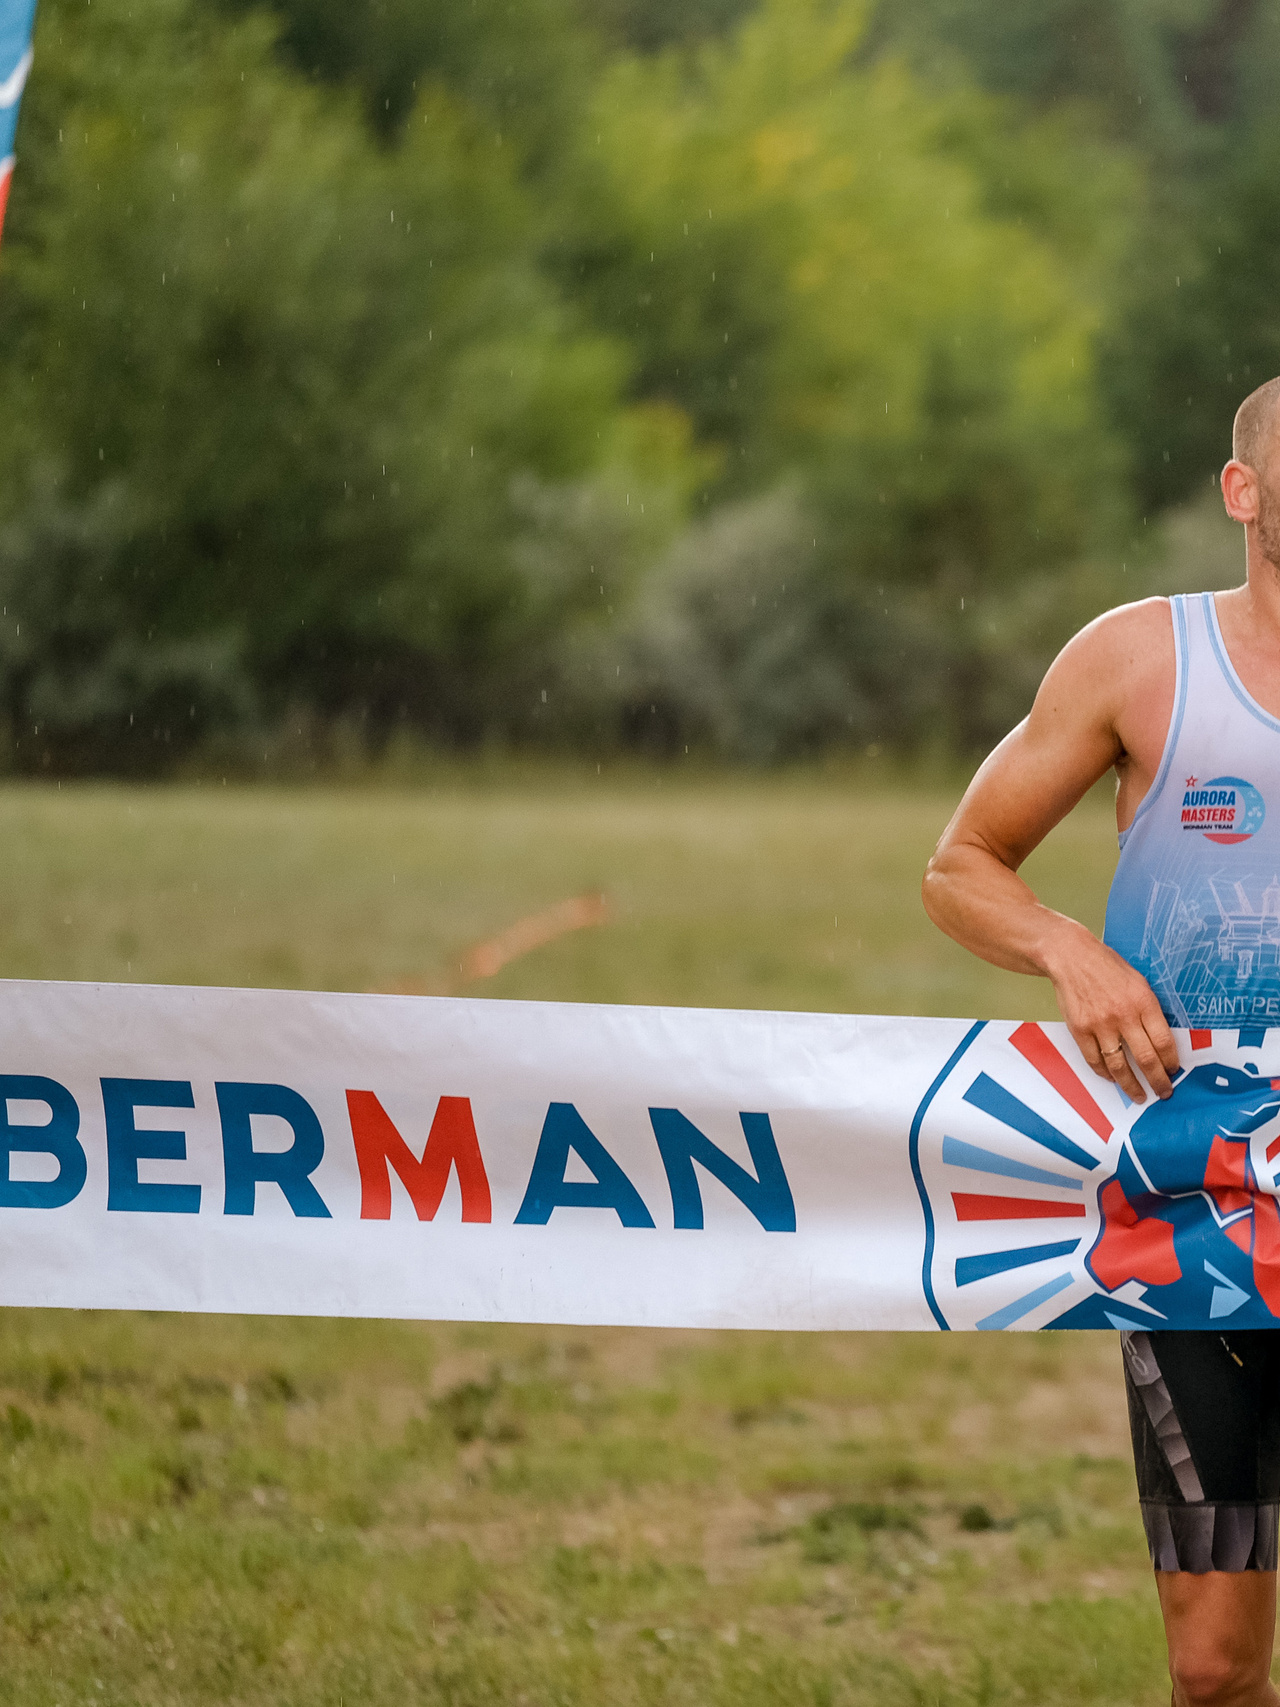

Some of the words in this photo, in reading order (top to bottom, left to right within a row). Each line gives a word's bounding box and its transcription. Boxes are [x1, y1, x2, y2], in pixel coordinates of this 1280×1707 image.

[1182, 790, 1236, 806] AURORA
[1181, 808, 1236, 822] MASTERS
[1198, 995, 1249, 1015] SAINT
[0, 1074, 797, 1233] BERMAN
